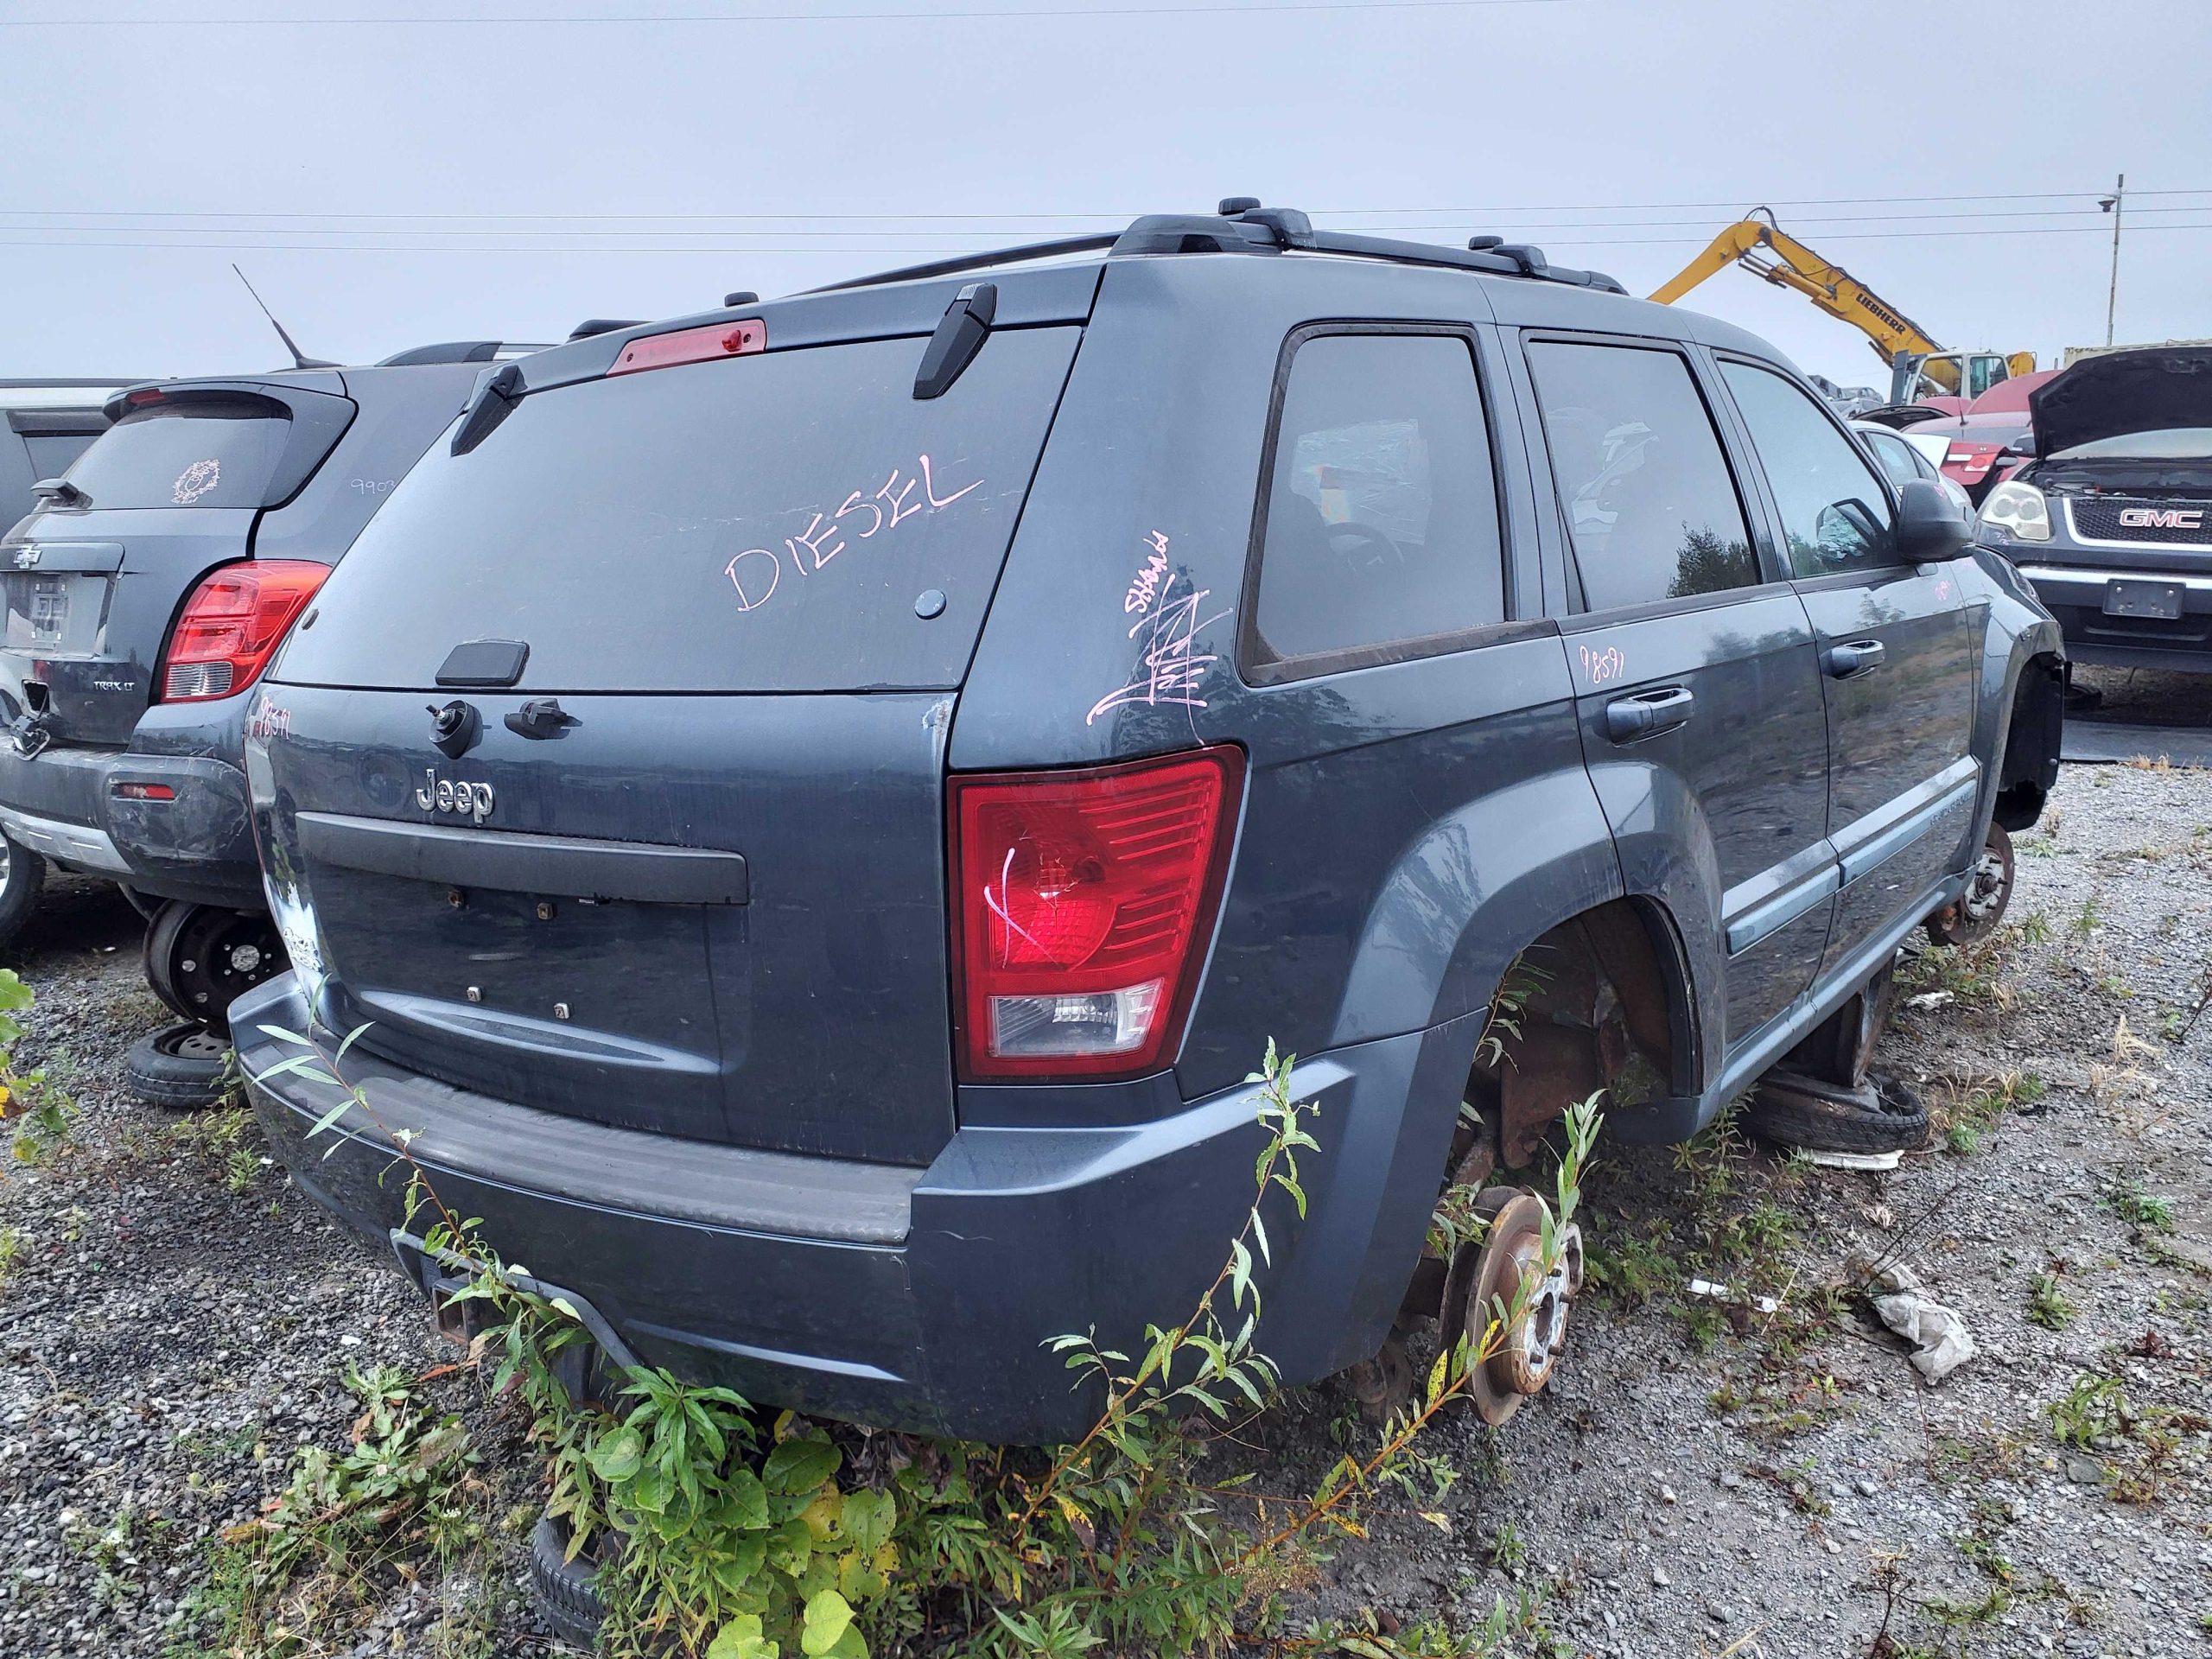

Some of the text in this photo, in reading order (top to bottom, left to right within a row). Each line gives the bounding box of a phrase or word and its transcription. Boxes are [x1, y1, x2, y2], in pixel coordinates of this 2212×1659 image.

[1856, 293, 1906, 335] LIEBHERR
[724, 454, 985, 613] DIESEL
[2120, 508, 2203, 529] GMC
[1580, 645, 1624, 684] 98591
[93, 681, 136, 691] TRAX LT
[416, 768, 495, 824] Jeep
